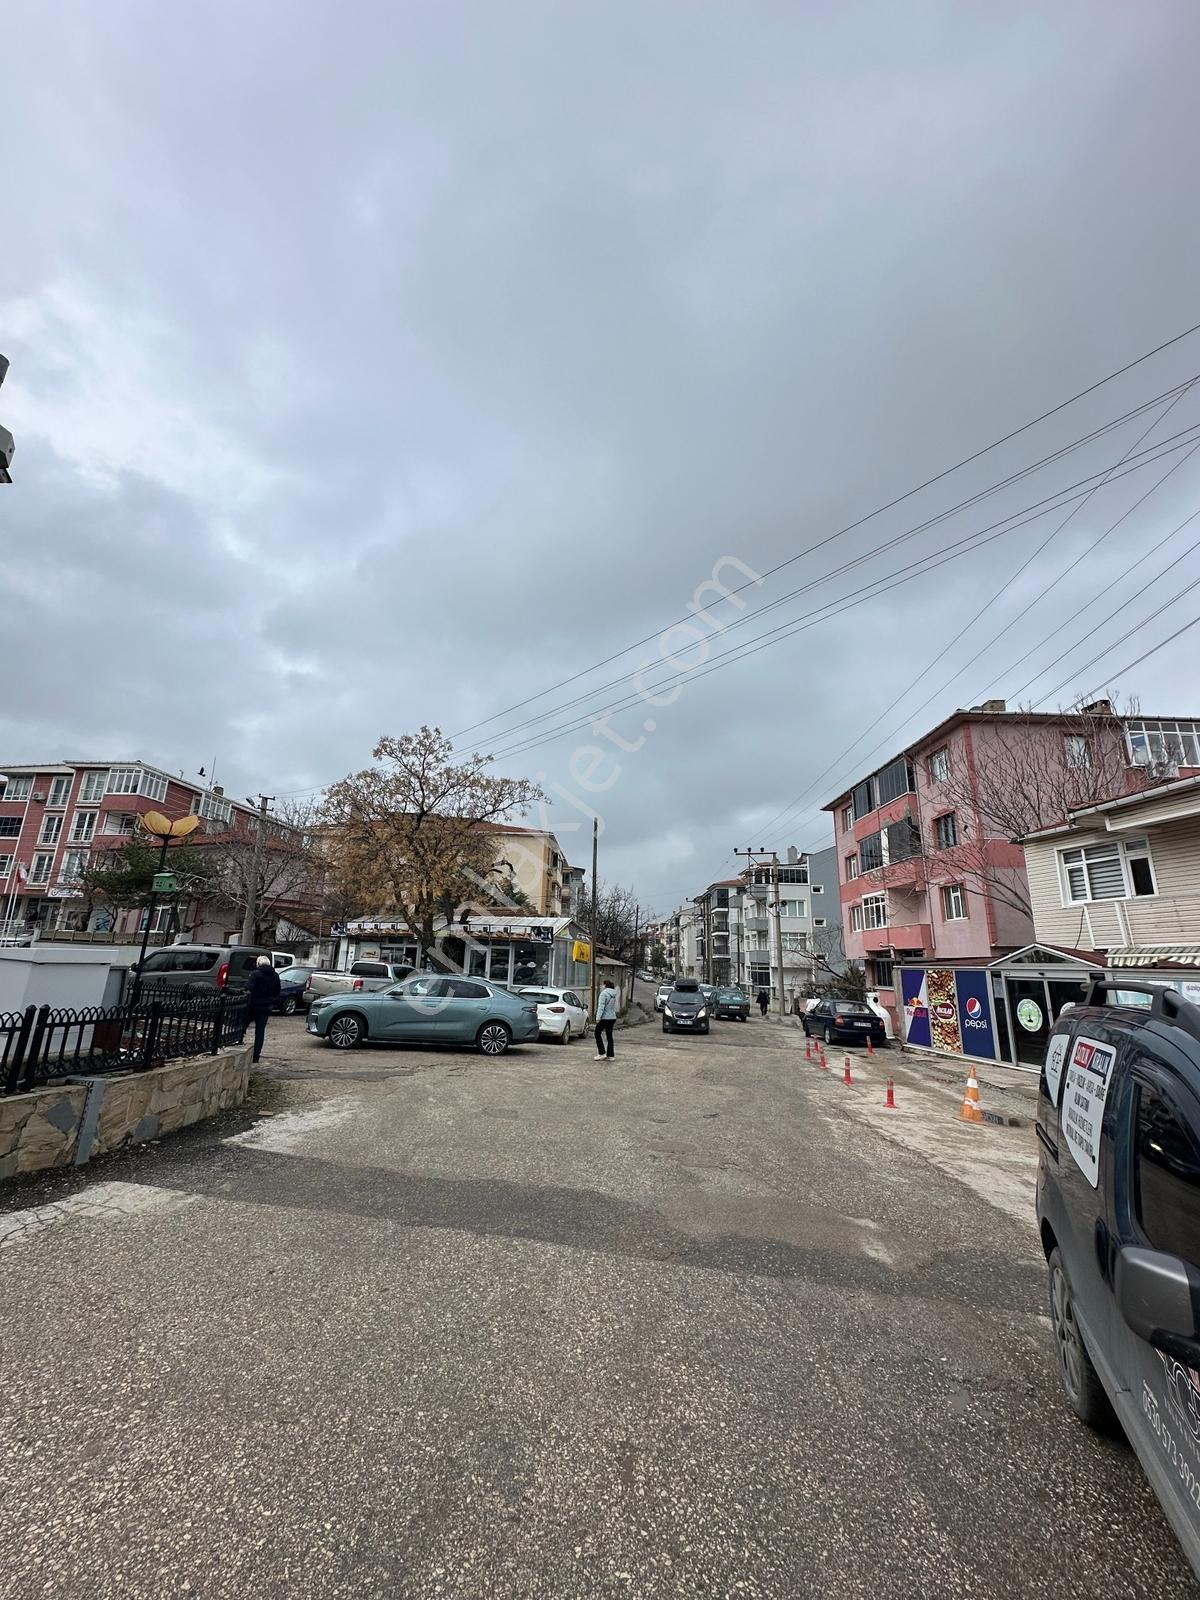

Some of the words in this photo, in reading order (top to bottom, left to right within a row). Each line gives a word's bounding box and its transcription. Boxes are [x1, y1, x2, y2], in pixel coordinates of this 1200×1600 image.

[964, 1018, 987, 1030] pepsi
[1142, 1390, 1161, 1436] 0530
[1162, 1423, 1177, 1466] 573
